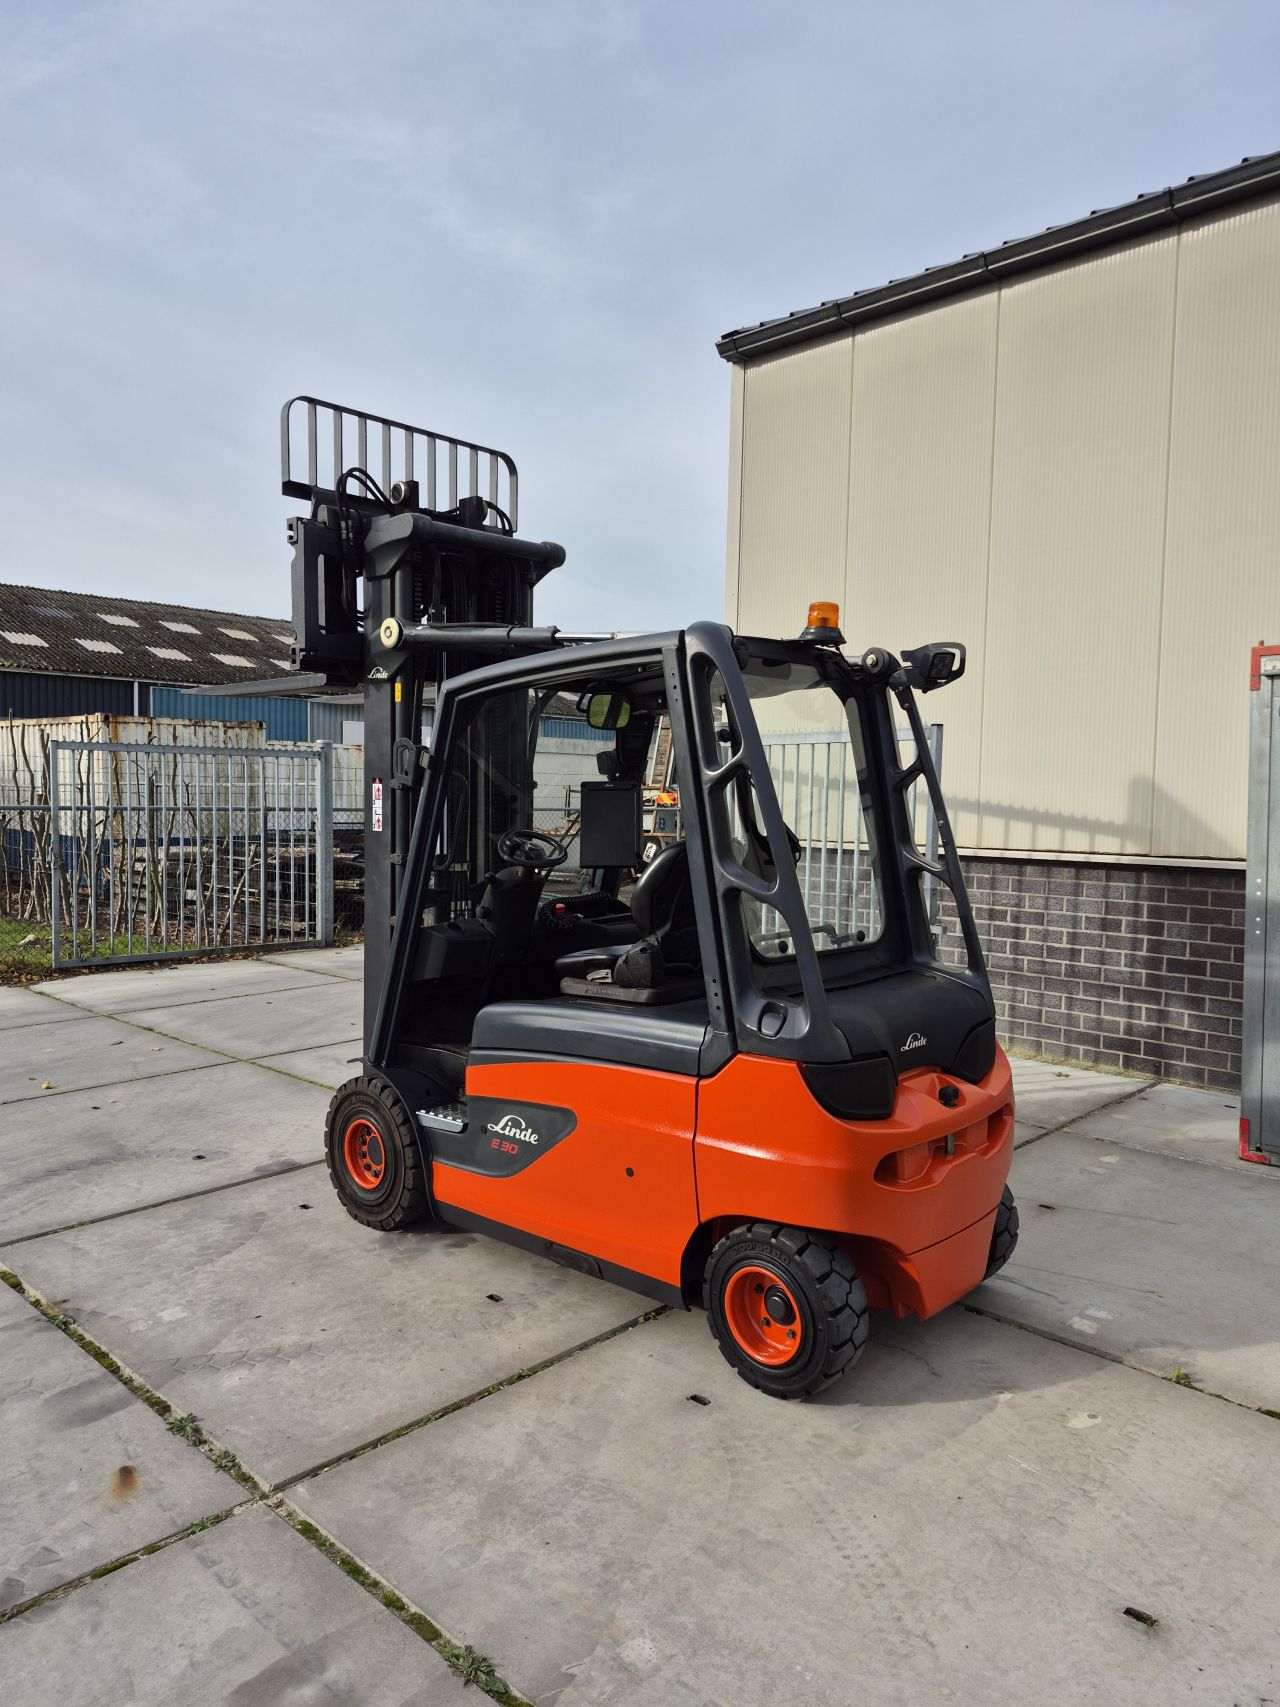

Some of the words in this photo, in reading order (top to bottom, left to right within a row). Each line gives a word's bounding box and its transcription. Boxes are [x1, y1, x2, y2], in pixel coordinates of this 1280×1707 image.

[366, 666, 389, 679] Linde
[900, 1032, 927, 1051] Linde
[487, 1115, 539, 1144] Linde
[491, 1138, 501, 1148] E
[500, 1141, 519, 1155] 30
